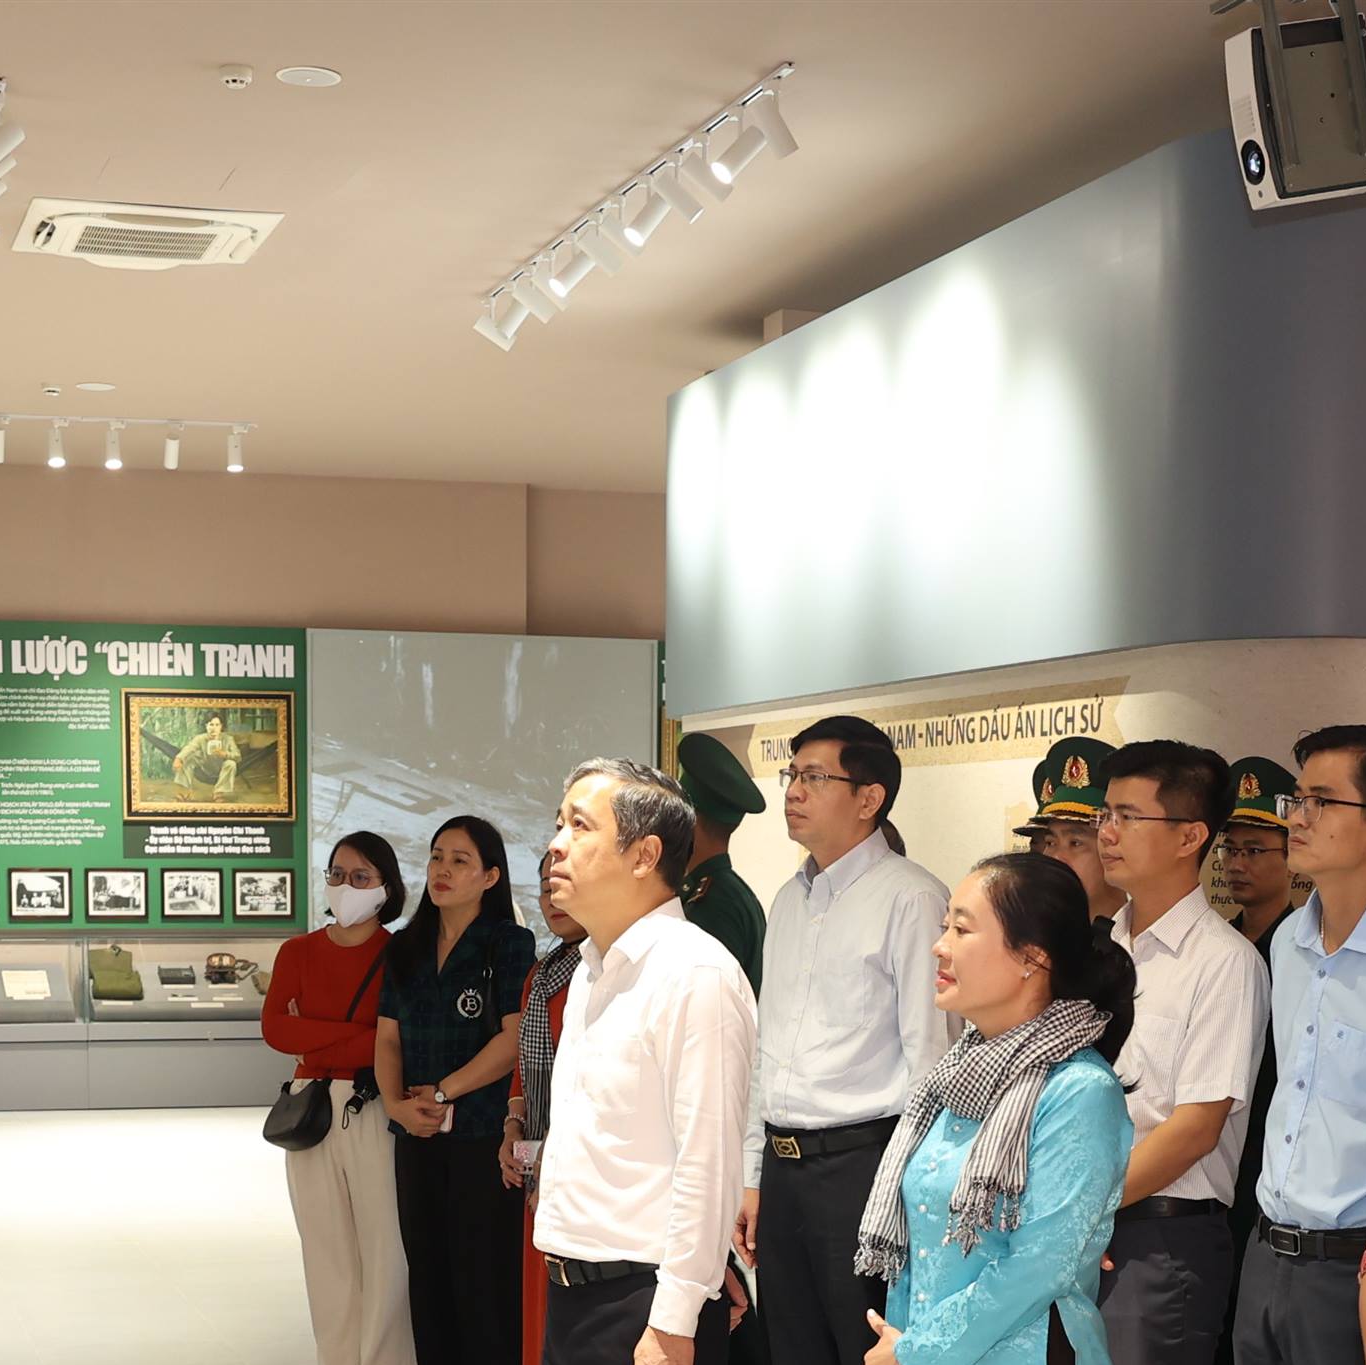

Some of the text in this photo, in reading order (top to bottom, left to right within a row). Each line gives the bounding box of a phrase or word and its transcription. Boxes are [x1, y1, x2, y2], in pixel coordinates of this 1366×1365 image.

[11, 635, 88, 681] LƯỢC
[200, 643, 295, 678] TRANH
[925, 713, 976, 748] NHỮNG
[980, 704, 1011, 743] DẤU
[1014, 702, 1036, 739] ẤN
[1040, 706, 1075, 744] LỊCH
[1080, 693, 1104, 734] SỬ
